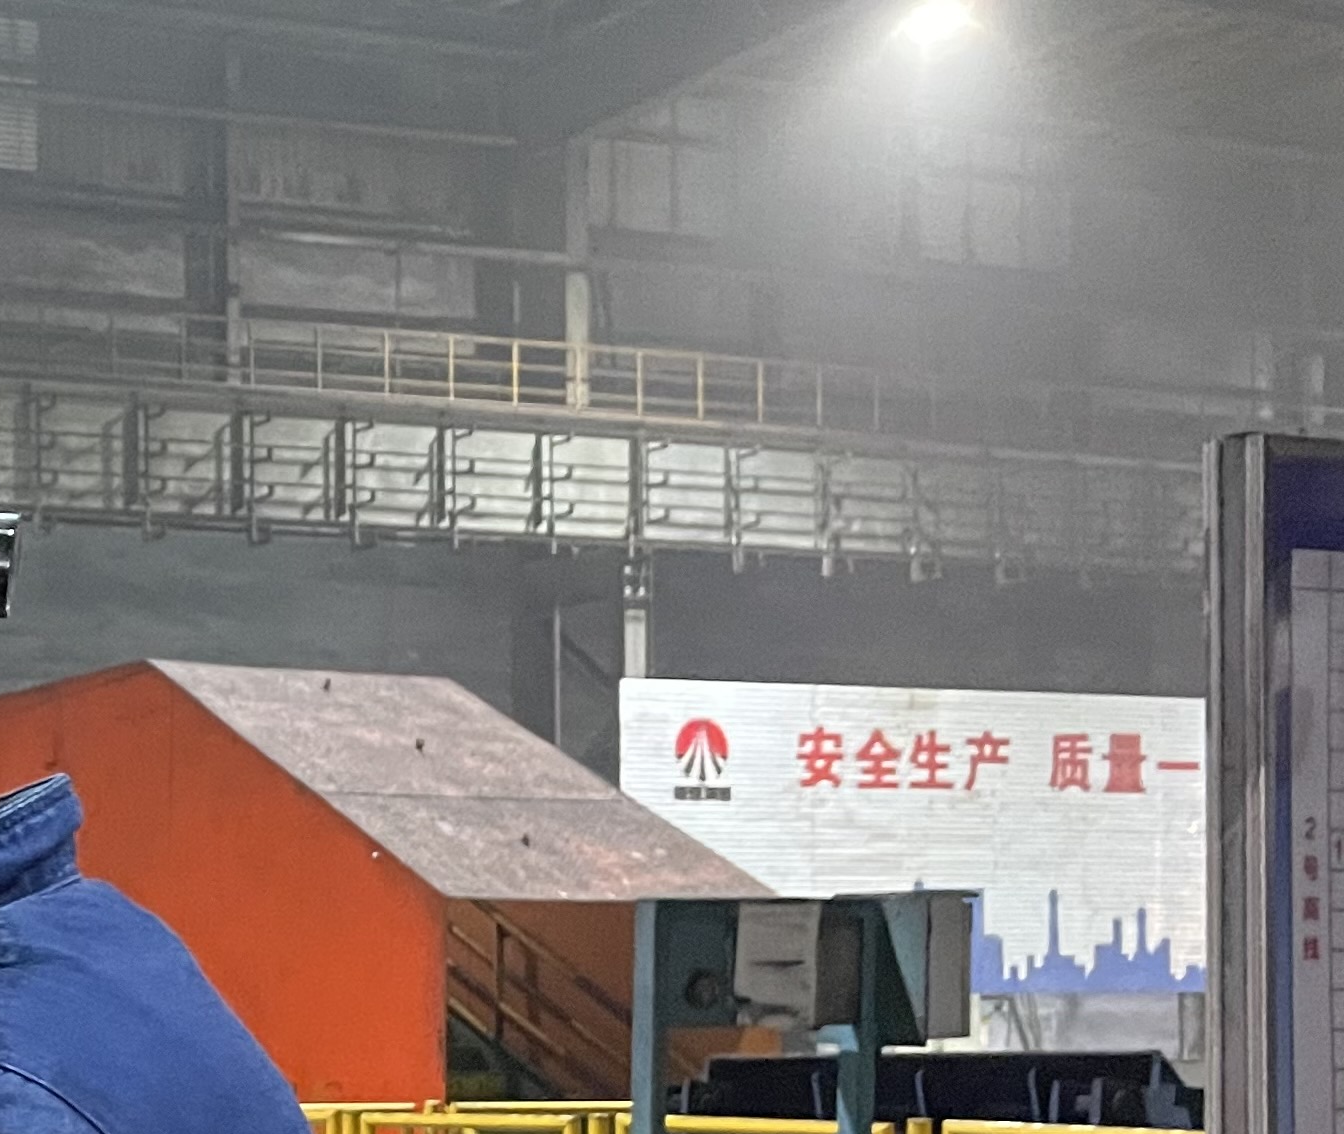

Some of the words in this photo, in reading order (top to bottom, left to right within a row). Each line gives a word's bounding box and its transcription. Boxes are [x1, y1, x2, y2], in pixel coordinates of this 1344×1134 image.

[795, 727, 1011, 790] 安全生产
[1049, 732, 1201, 793] 质量一
